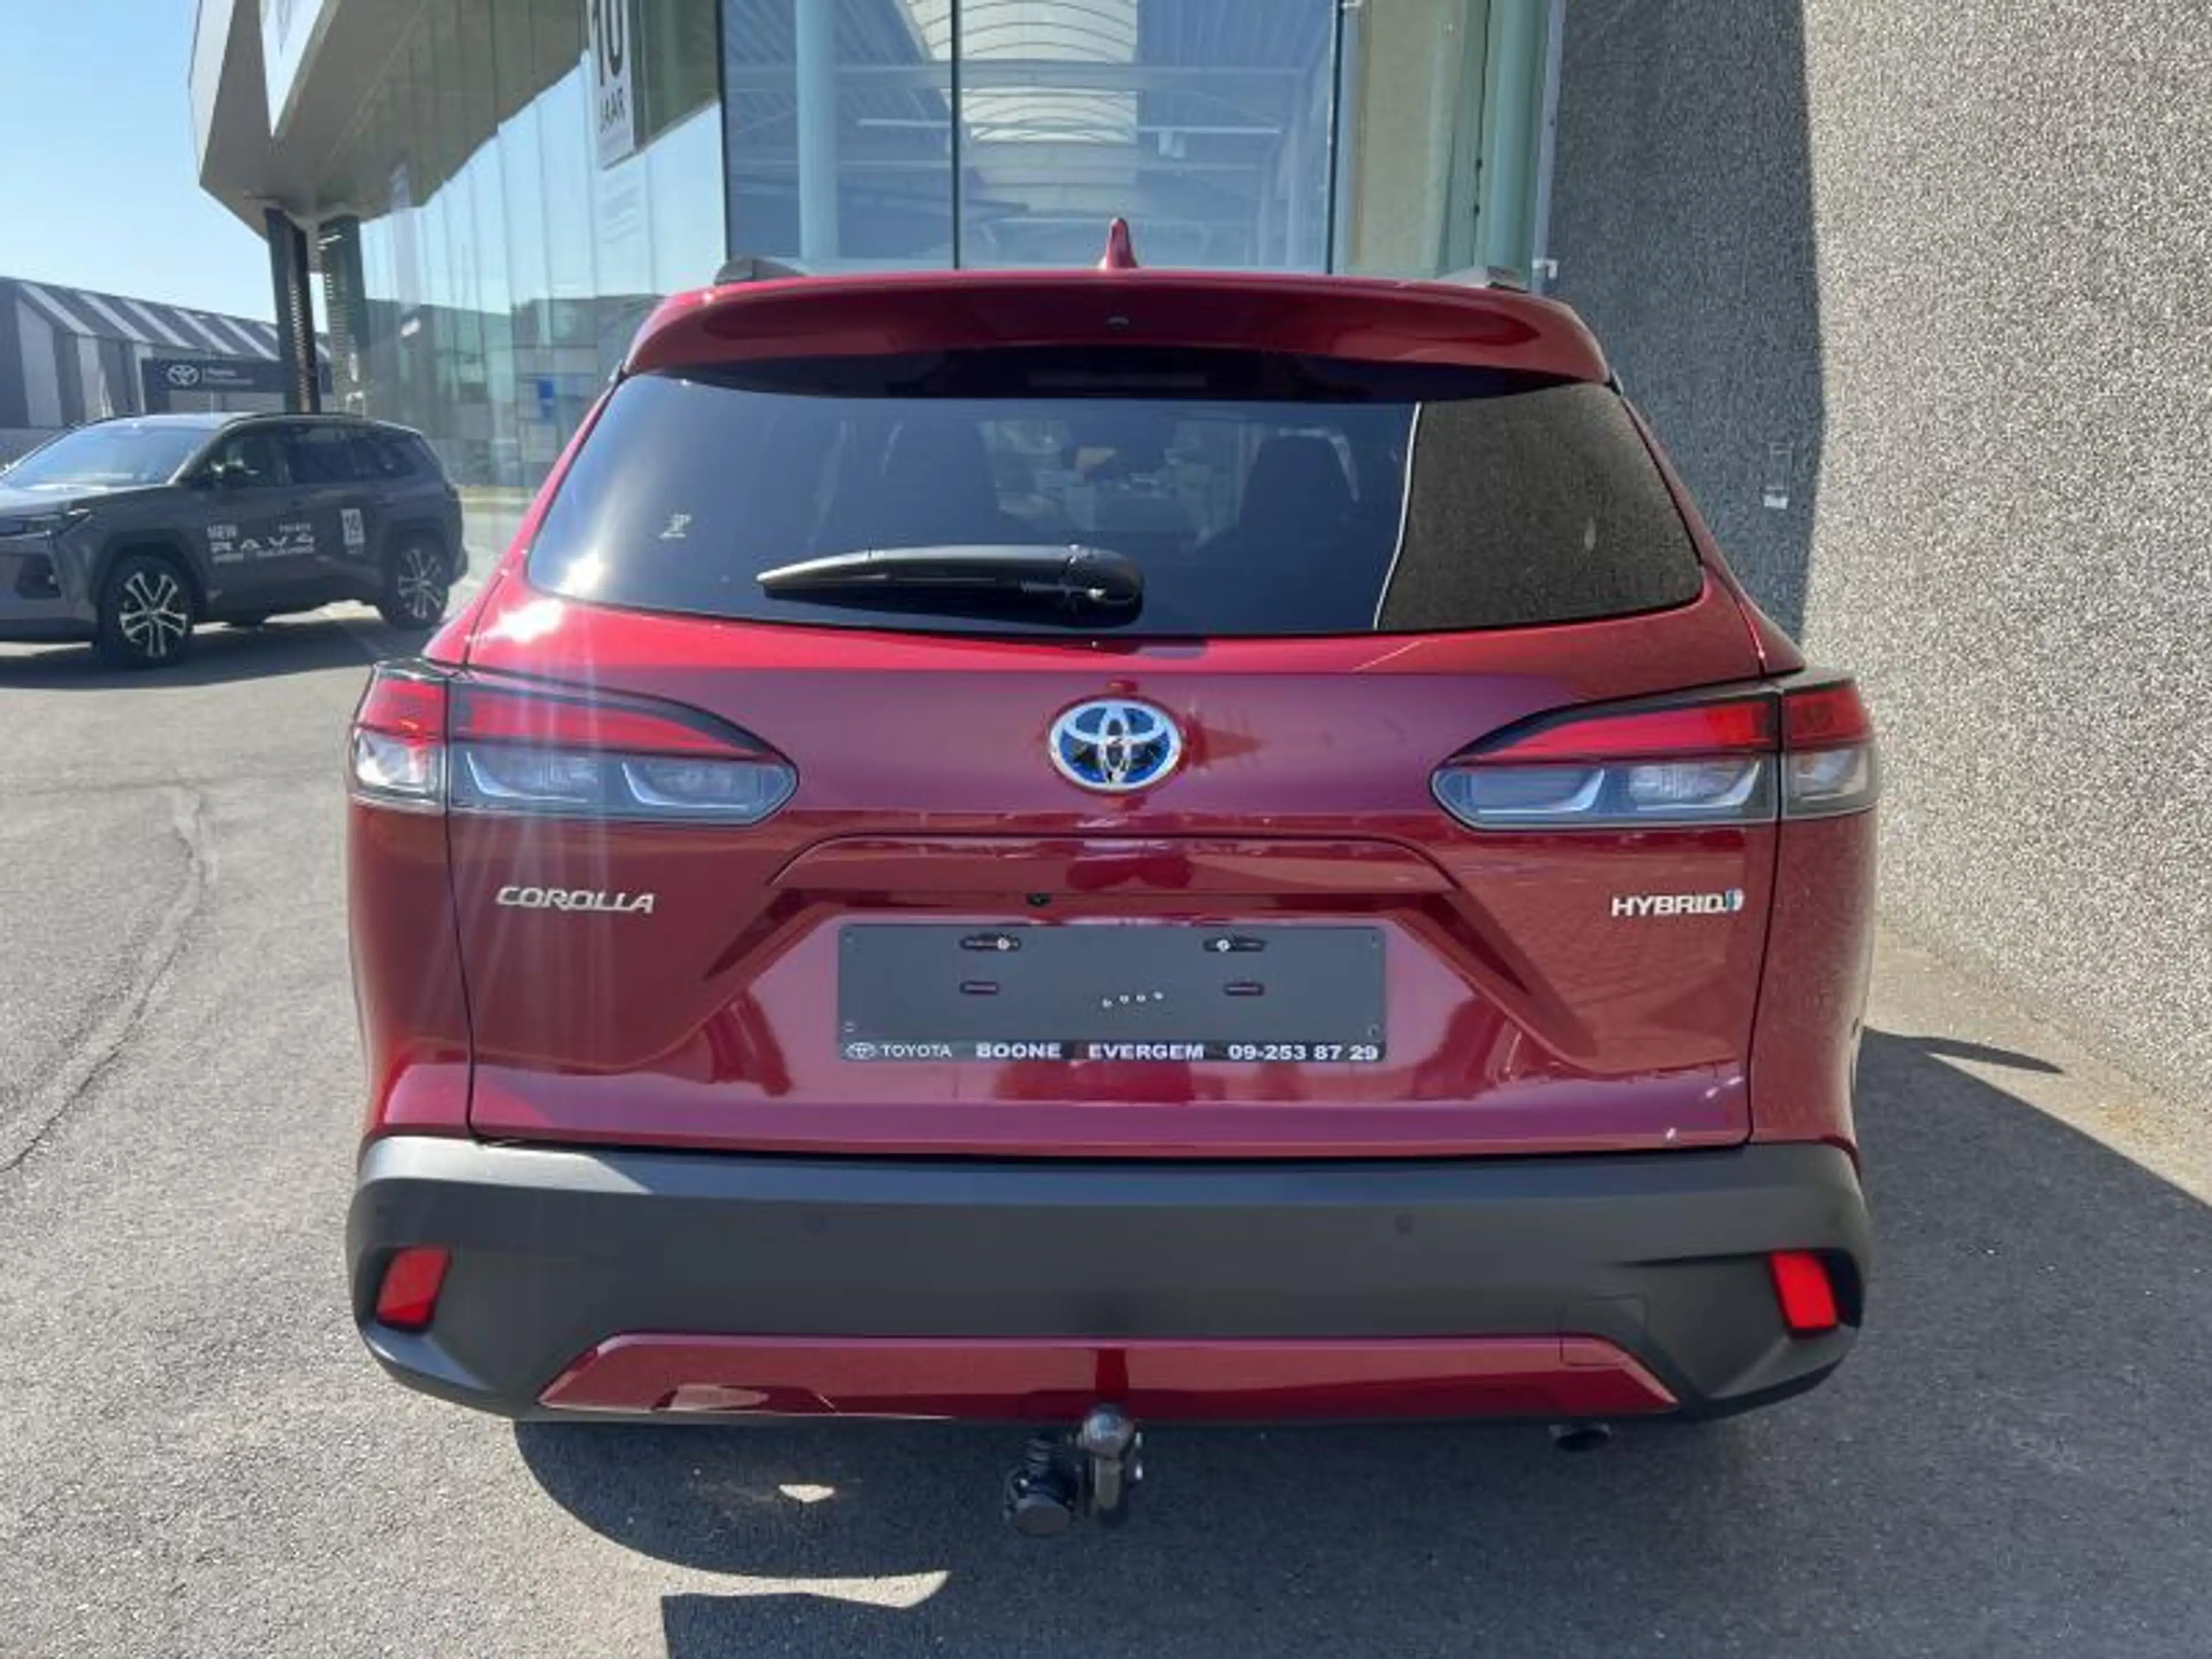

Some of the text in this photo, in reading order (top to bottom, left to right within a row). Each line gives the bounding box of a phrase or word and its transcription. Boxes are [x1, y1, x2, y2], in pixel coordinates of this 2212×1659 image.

[496, 887, 654, 913] COROLLA
[1611, 895, 1726, 916] HYBRID
[882, 1042, 1379, 1061] TOYOTA BOONE EVERGEM 09-253 87 29
